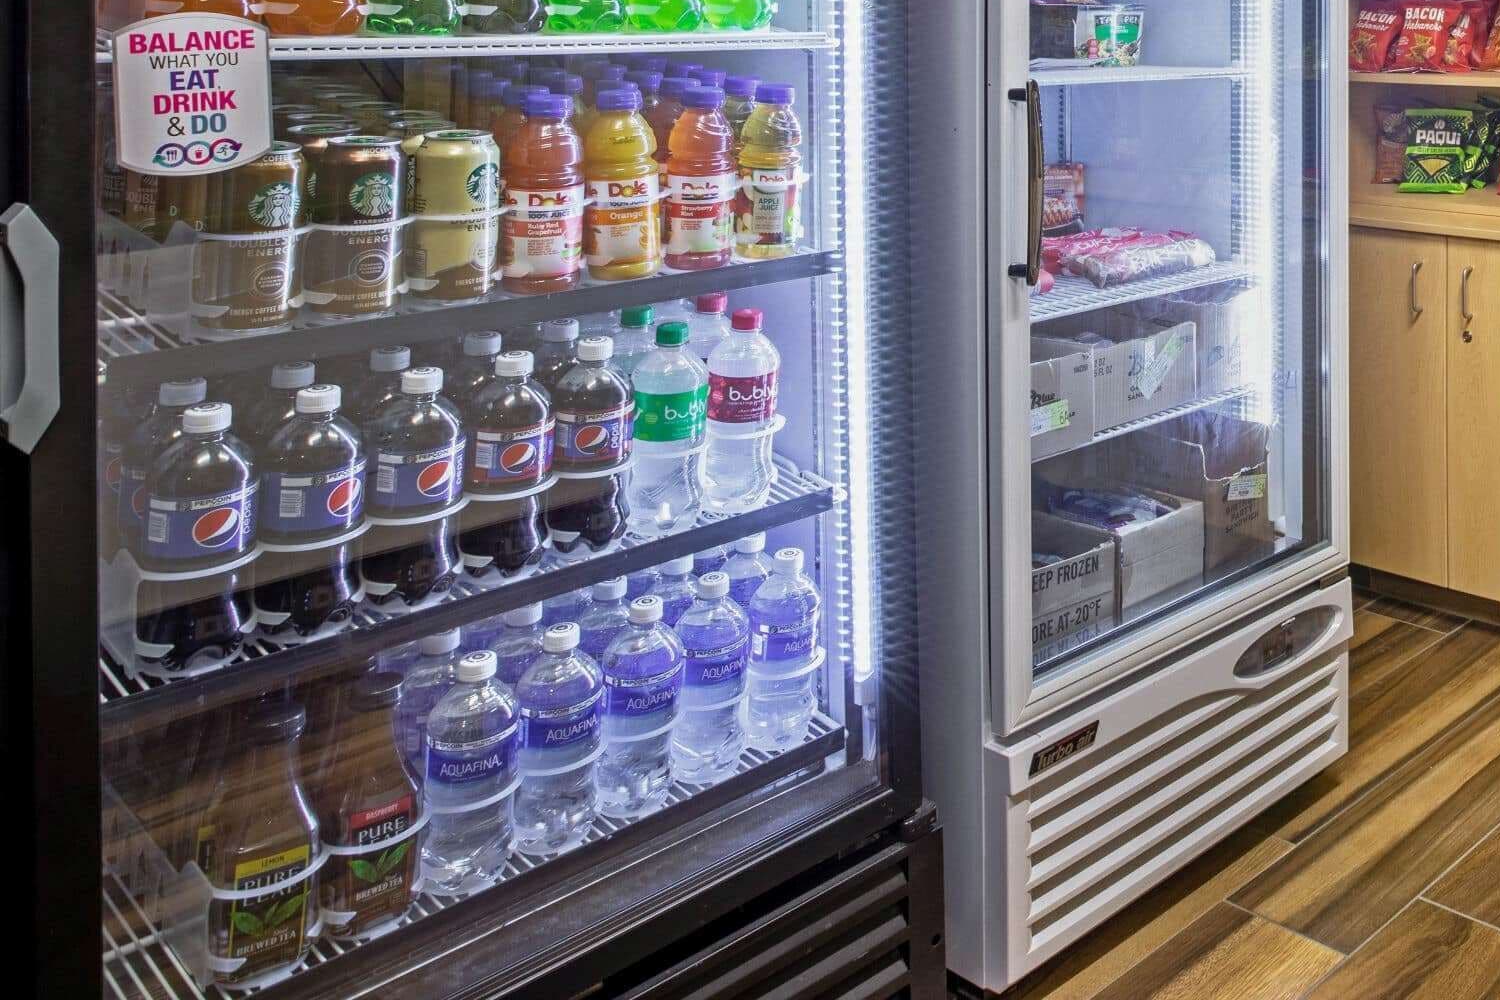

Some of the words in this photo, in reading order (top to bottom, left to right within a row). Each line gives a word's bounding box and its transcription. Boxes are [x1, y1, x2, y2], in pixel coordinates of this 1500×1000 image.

[1358, 10, 1397, 25] BACON
[1403, 20, 1443, 32] Habanero
[1405, 7, 1445, 23] BACON
[129, 29, 256, 54] BALANCE
[150, 53, 201, 70] WHAT
[206, 52, 239, 67] YOU
[153, 90, 238, 115] DRINK
[167, 116, 185, 136] &
[191, 113, 227, 135] DO
[608, 180, 650, 198] Dole
[609, 210, 644, 220] Orange
[247, 248, 292, 257] ENERG
[611, 422, 620, 449] pepsi
[1032, 569, 1053, 594] EEP
[1057, 554, 1100, 585] FROZEN
[1032, 618, 1054, 645] ORE
[626, 684, 682, 711] AQUAFINA
[545, 714, 598, 744] AQUAFINA
[439, 753, 503, 777] AQUAFINA
[358, 816, 407, 843] PURE
[261, 855, 285, 867] LEMON
[355, 882, 389, 901] BREWED
[389, 876, 404, 890] TEA
[279, 929, 297, 945] TEA
